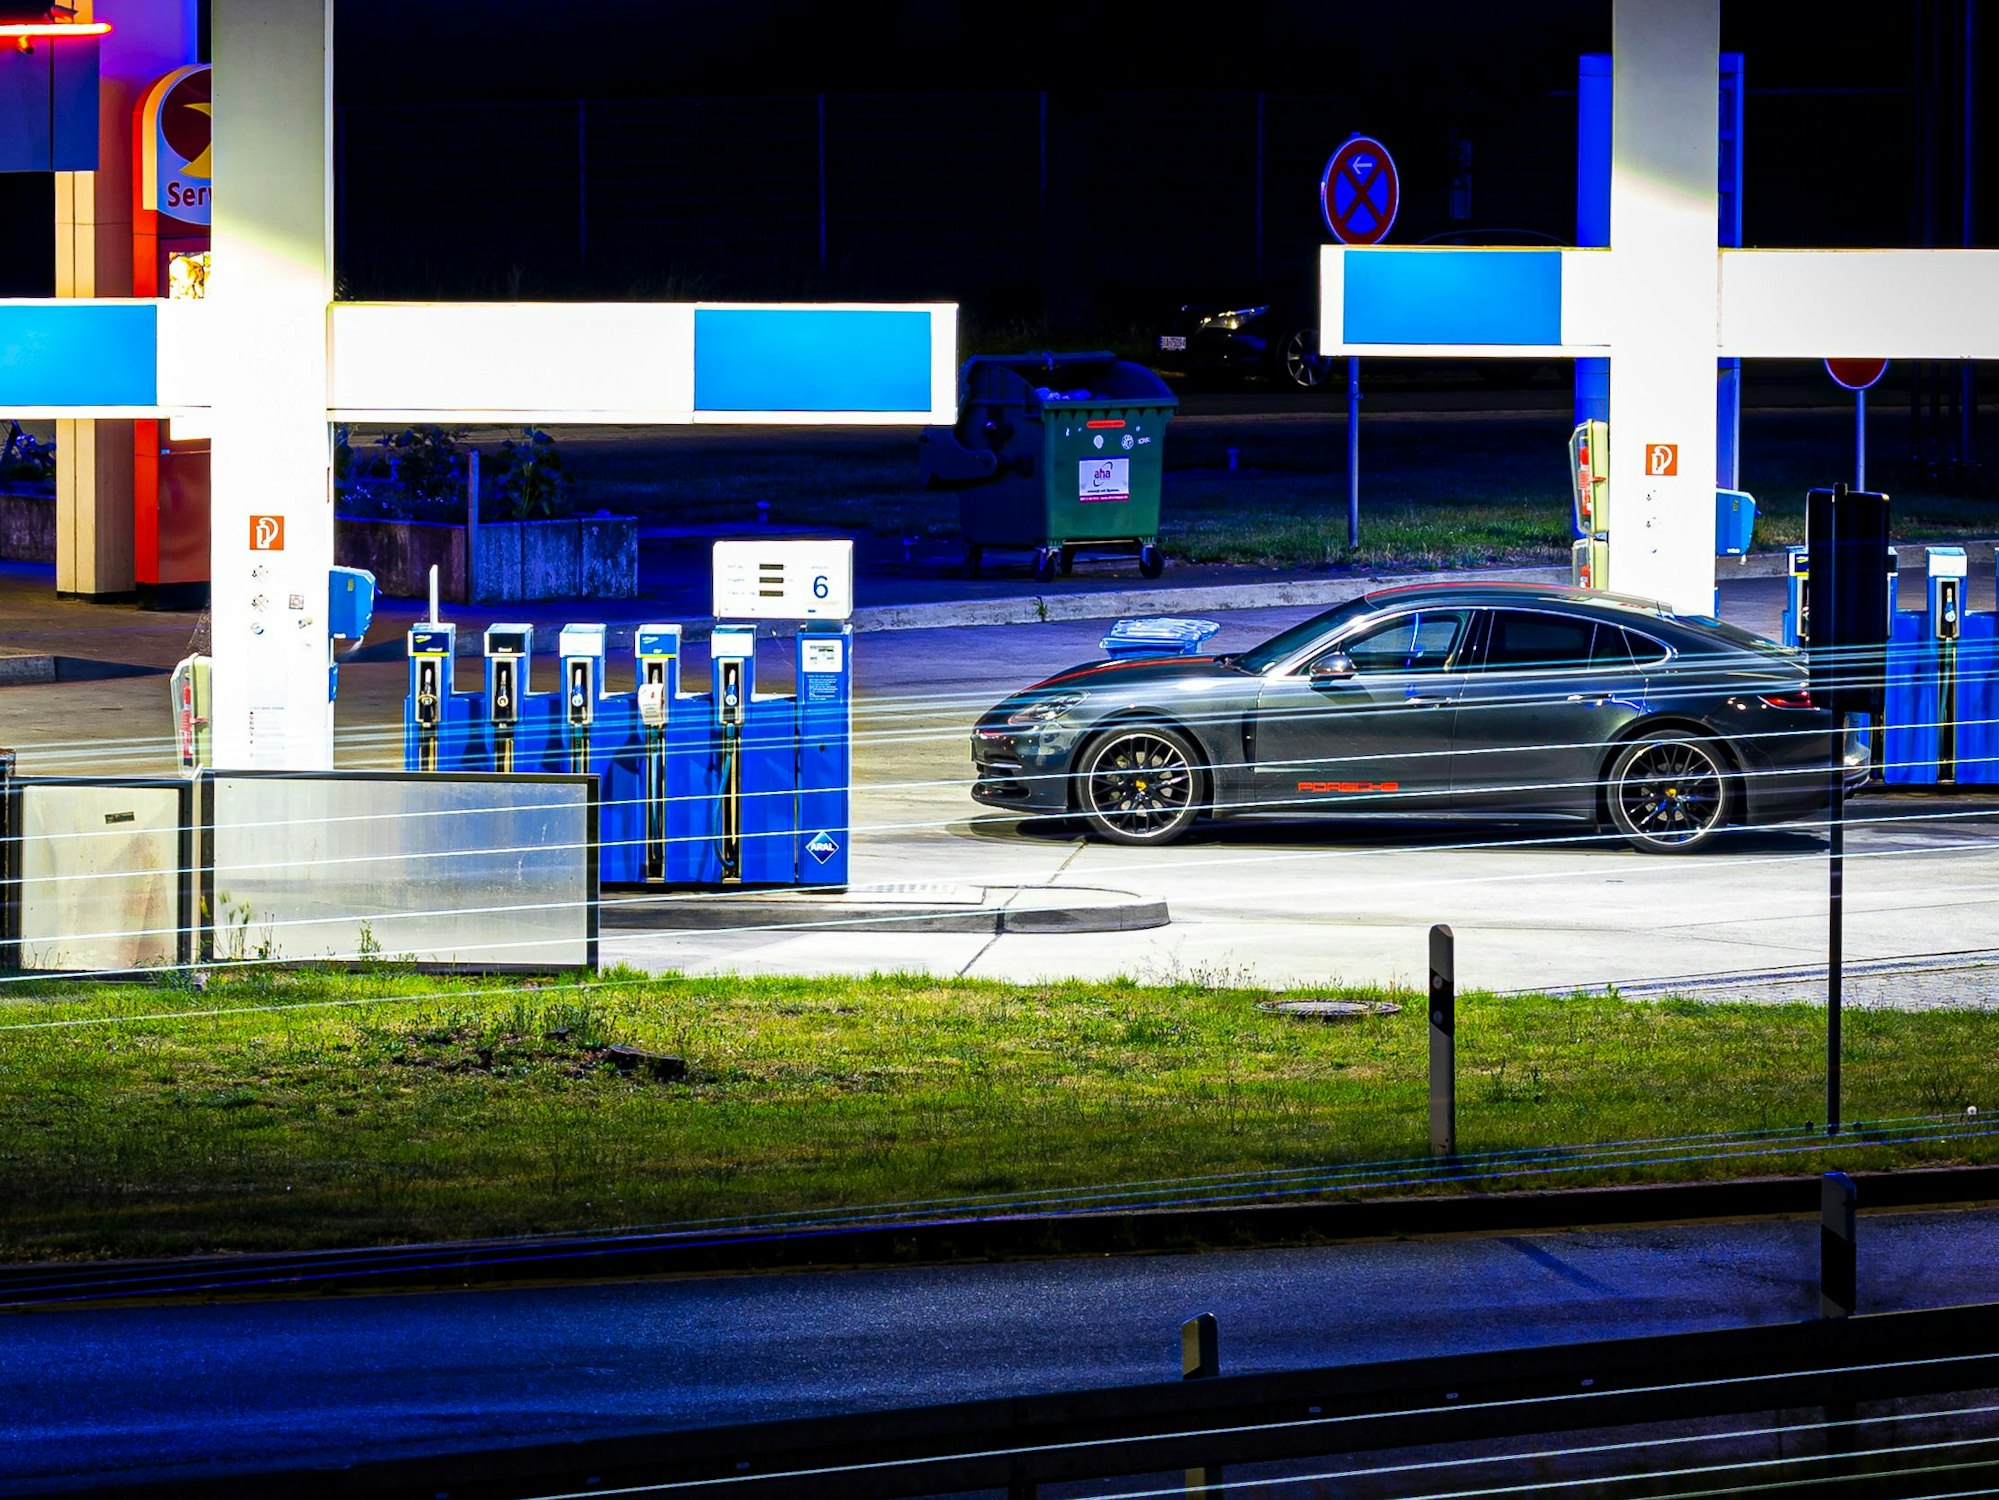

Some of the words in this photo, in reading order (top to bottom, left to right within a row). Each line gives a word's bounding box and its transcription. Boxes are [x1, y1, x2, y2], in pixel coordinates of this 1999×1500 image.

[1094, 468, 1111, 479] aha
[813, 575, 829, 599] 6
[810, 842, 834, 852] ARAL
